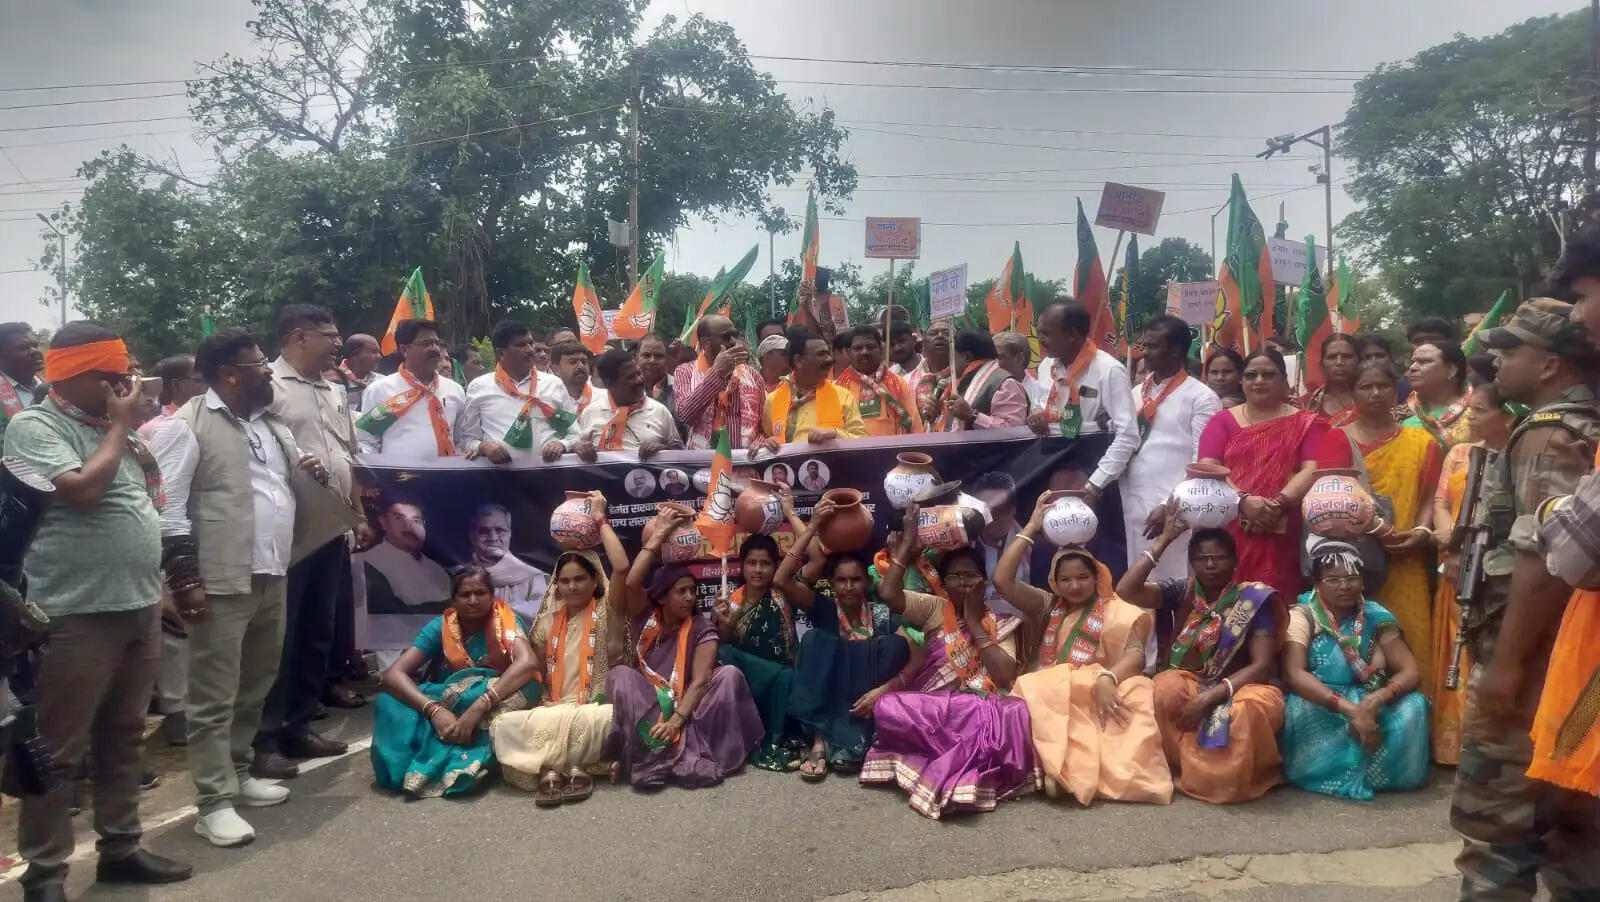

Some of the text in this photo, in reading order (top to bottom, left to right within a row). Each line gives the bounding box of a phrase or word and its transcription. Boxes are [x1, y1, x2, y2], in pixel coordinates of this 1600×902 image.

[1187, 485, 1209, 496] पानी
[1314, 478, 1354, 493] पानी दो
[607, 500, 658, 515] हेमंत सरका
[1182, 501, 1230, 515] बिजली दो
[1348, 501, 1359, 513] दो
[1049, 514, 1091, 528] बिजली दो
